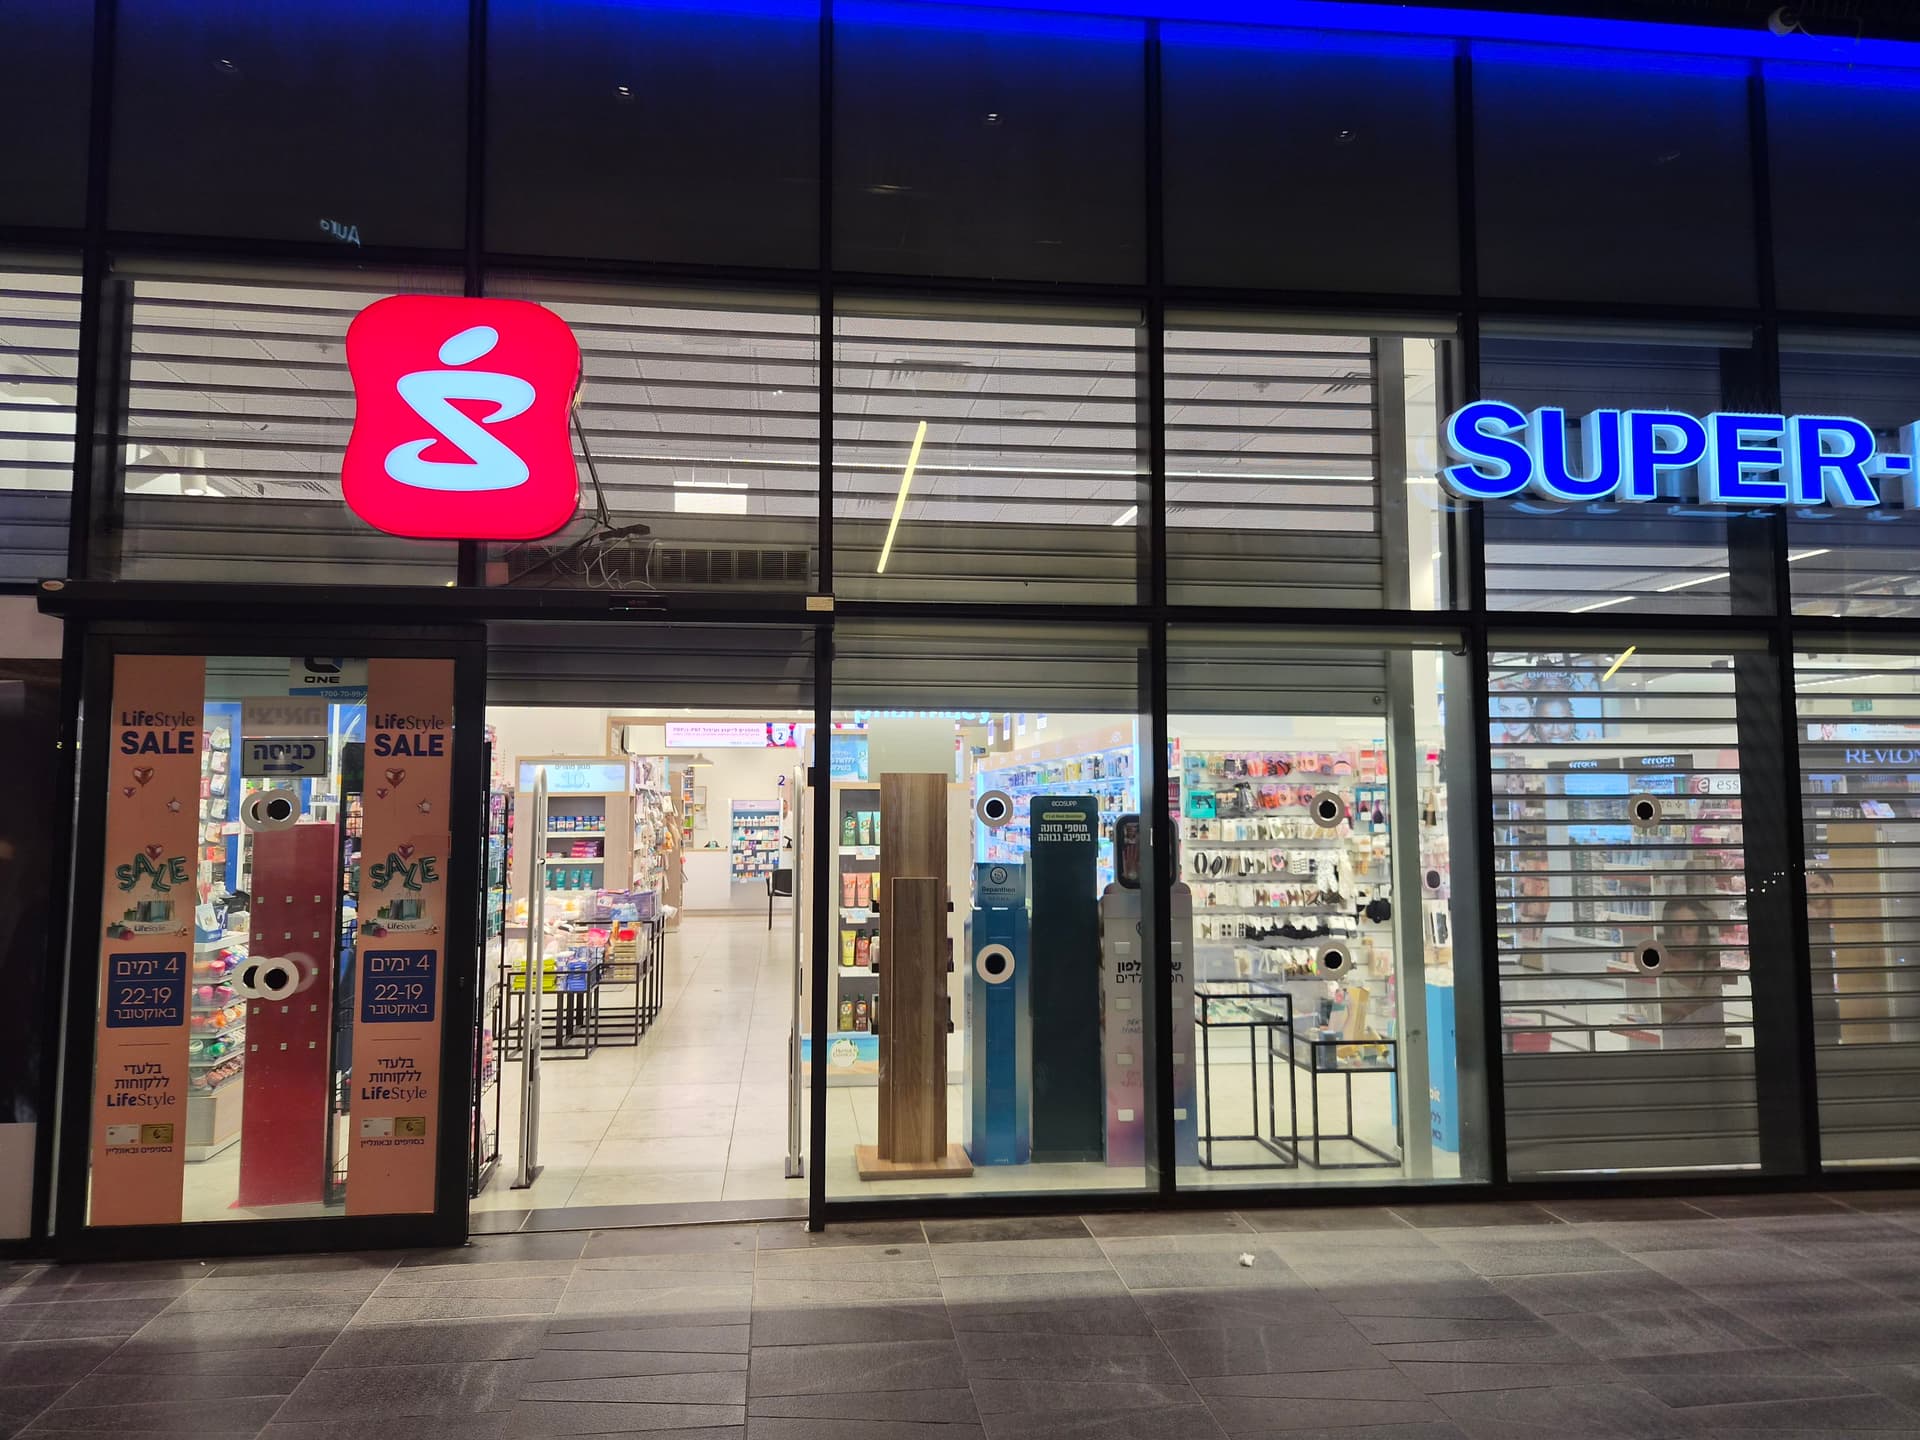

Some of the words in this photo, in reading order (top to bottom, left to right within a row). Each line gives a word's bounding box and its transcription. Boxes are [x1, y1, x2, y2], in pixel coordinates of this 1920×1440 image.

[1440, 400, 1920, 508] SUPER-
[122, 711, 195, 731] LifeStyle
[375, 714, 444, 734] LifeStyle
[121, 731, 194, 755] SALE
[374, 733, 444, 757] SALE
[253, 744, 316, 760] כניסה
[777, 775, 786, 786] 2
[1040, 824, 1063, 832] תזונה
[1065, 824, 1088, 832] תוספי
[1038, 834, 1061, 842] גבוהה
[1063, 833, 1091, 842] בספיגה
[115, 853, 189, 892] SALE
[369, 852, 439, 891] SALE
[117, 960, 158, 975] ימים
[164, 957, 179, 974] 4
[371, 957, 410, 972] ימים
[416, 955, 430, 971] 4
[120, 987, 172, 1005] 22-19
[374, 983, 423, 1001] 22-19
[114, 1007, 176, 1021] באוקטובר
[368, 1003, 429, 1017] באוקטובר
[124, 1062, 162, 1074] בלעדי
[377, 1056, 414, 1069] בלעדי
[114, 1076, 170, 1091] ללקוחות
[368, 1070, 422, 1085] ללקוחות
[106, 1092, 176, 1110] LifeStyle
[362, 1086, 428, 1103] LifeStyle
